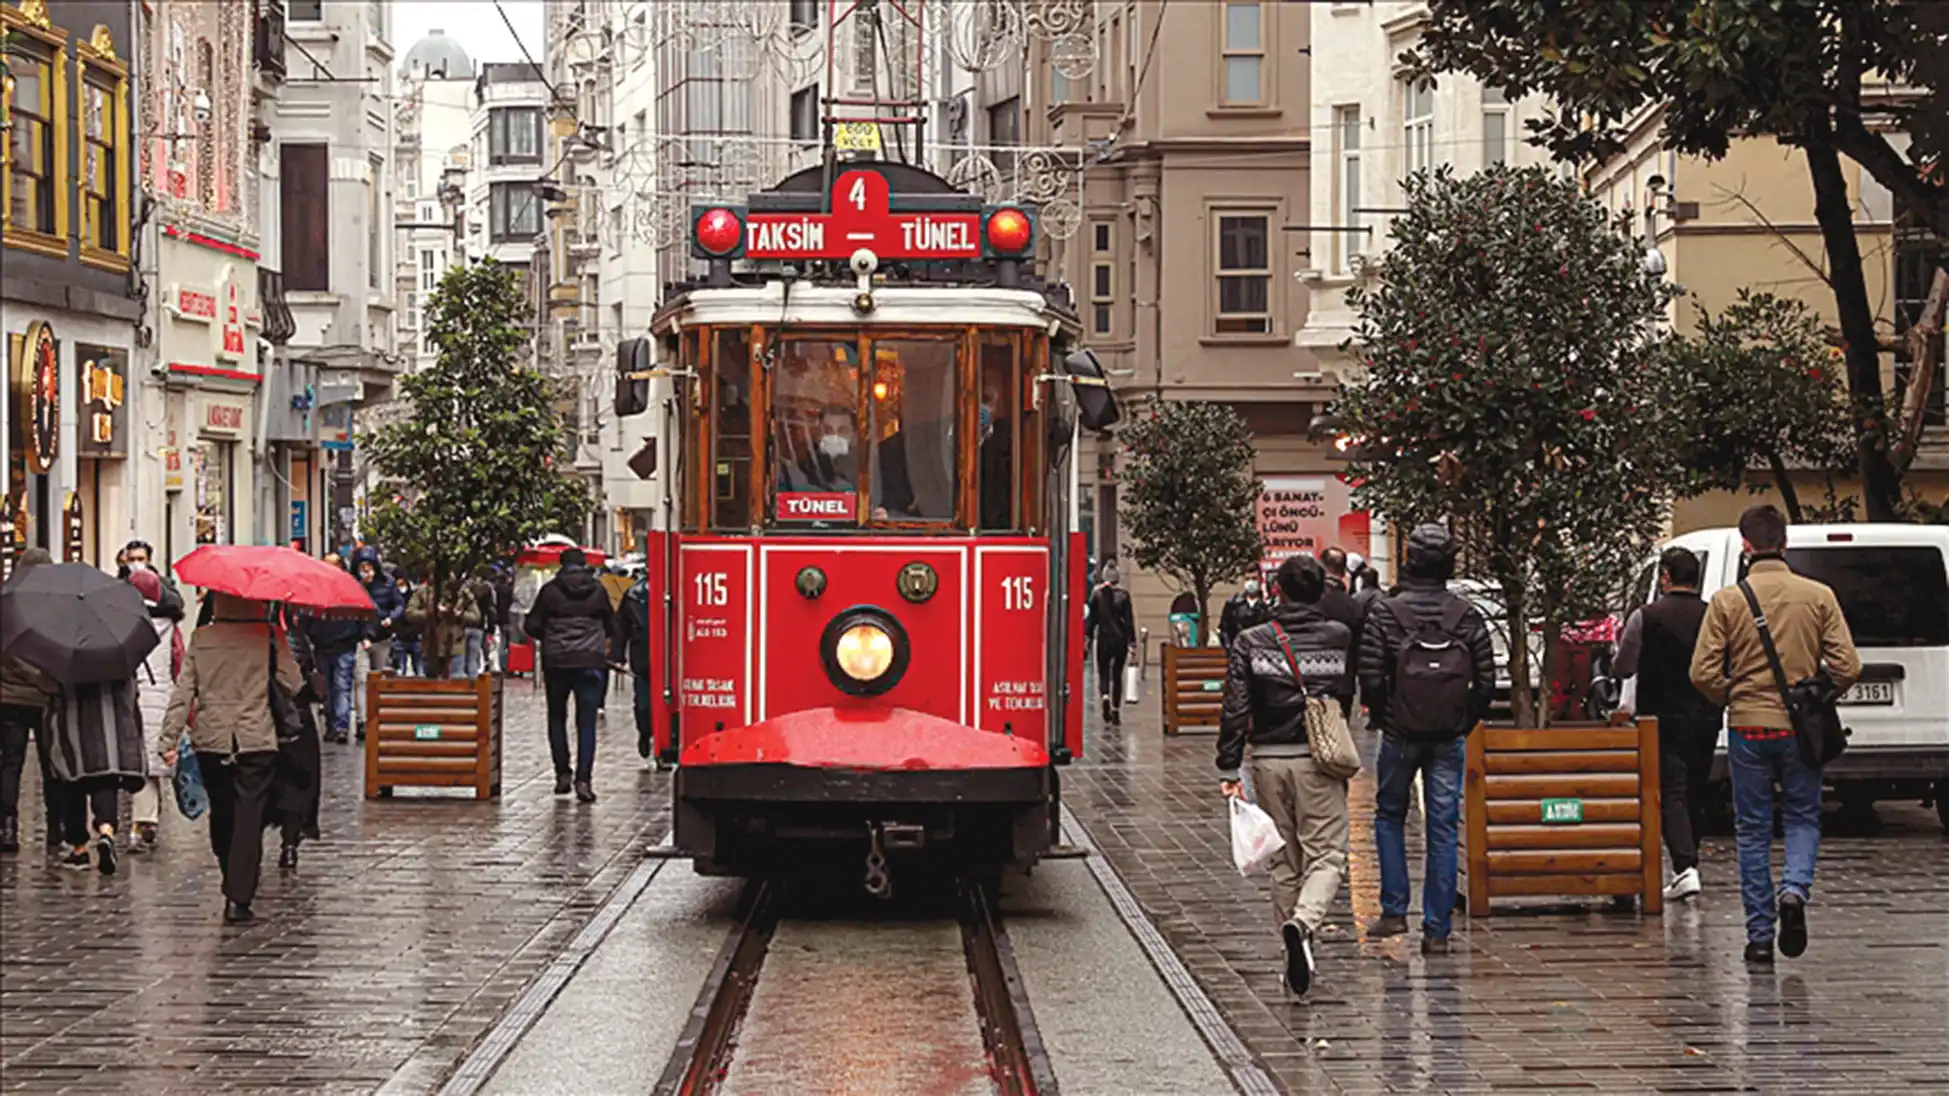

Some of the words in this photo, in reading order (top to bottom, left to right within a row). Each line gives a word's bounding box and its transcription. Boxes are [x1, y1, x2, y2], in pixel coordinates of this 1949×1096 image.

[849, 177, 866, 211] 4
[747, 217, 824, 251] TAKSİM
[901, 217, 975, 251] TÜNEL
[787, 496, 848, 514] TÜNEL
[694, 572, 728, 606] 115
[1001, 576, 1033, 610] 115
[1855, 684, 1888, 700] 3161
